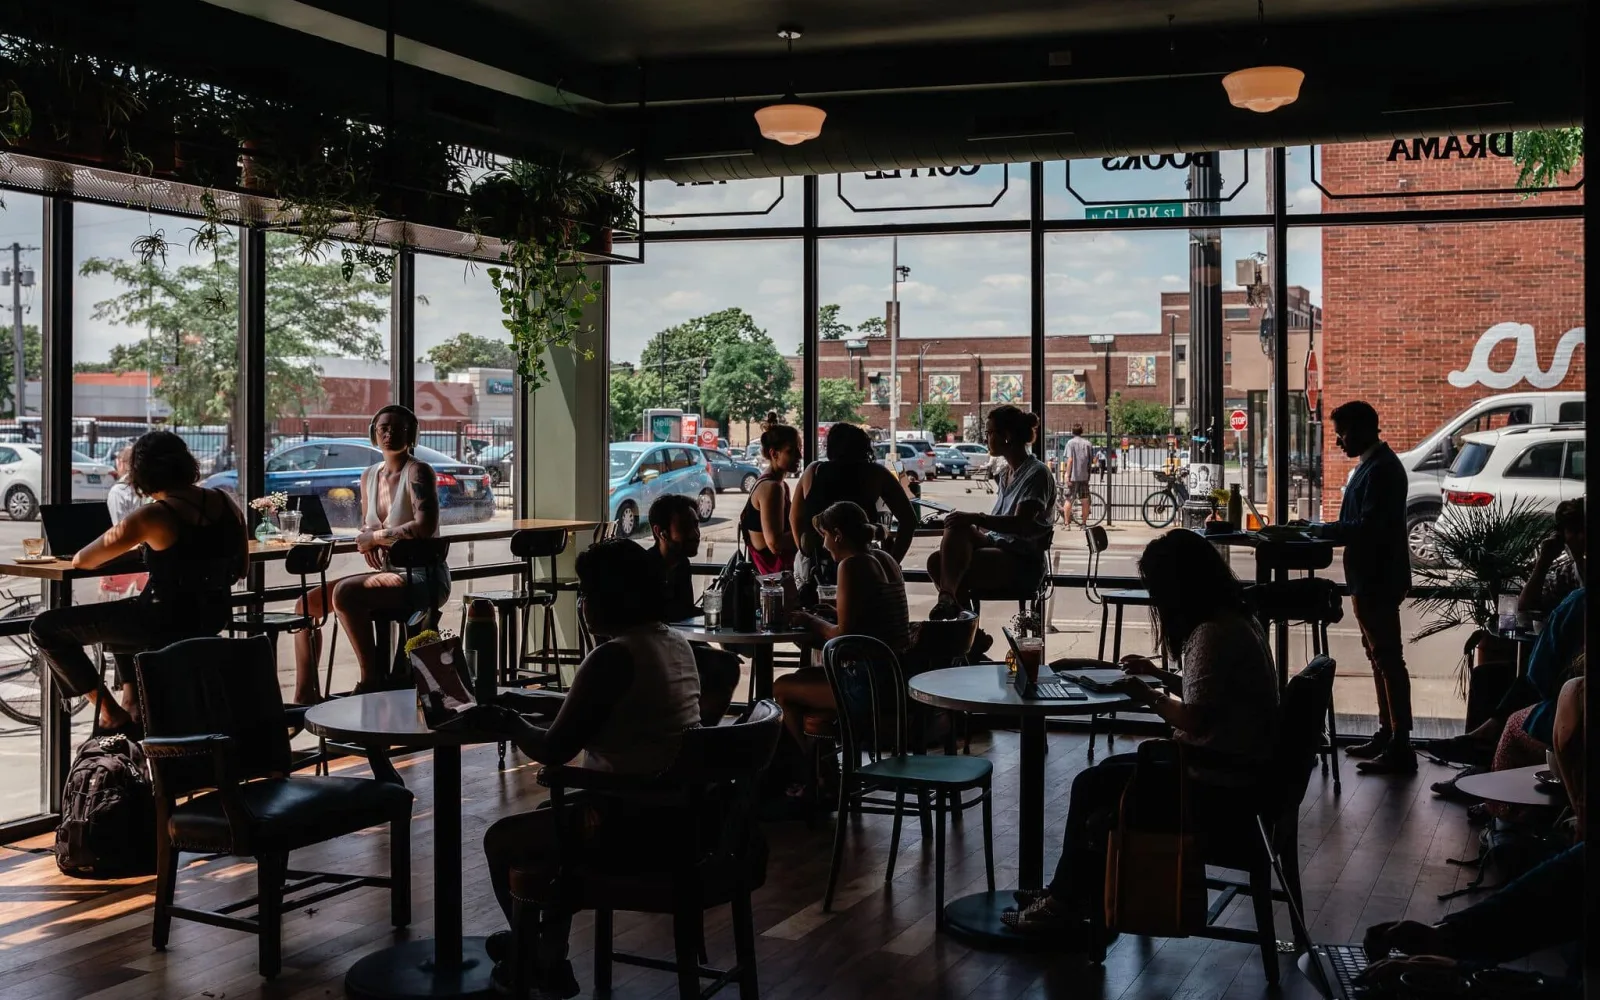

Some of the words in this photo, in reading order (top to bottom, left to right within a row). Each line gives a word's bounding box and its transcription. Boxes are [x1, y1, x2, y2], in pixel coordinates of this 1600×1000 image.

[1105, 206, 1159, 219] CLARK
[1163, 208, 1176, 218] ST
[653, 417, 674, 427] Hello
[1231, 416, 1246, 425] STOP
